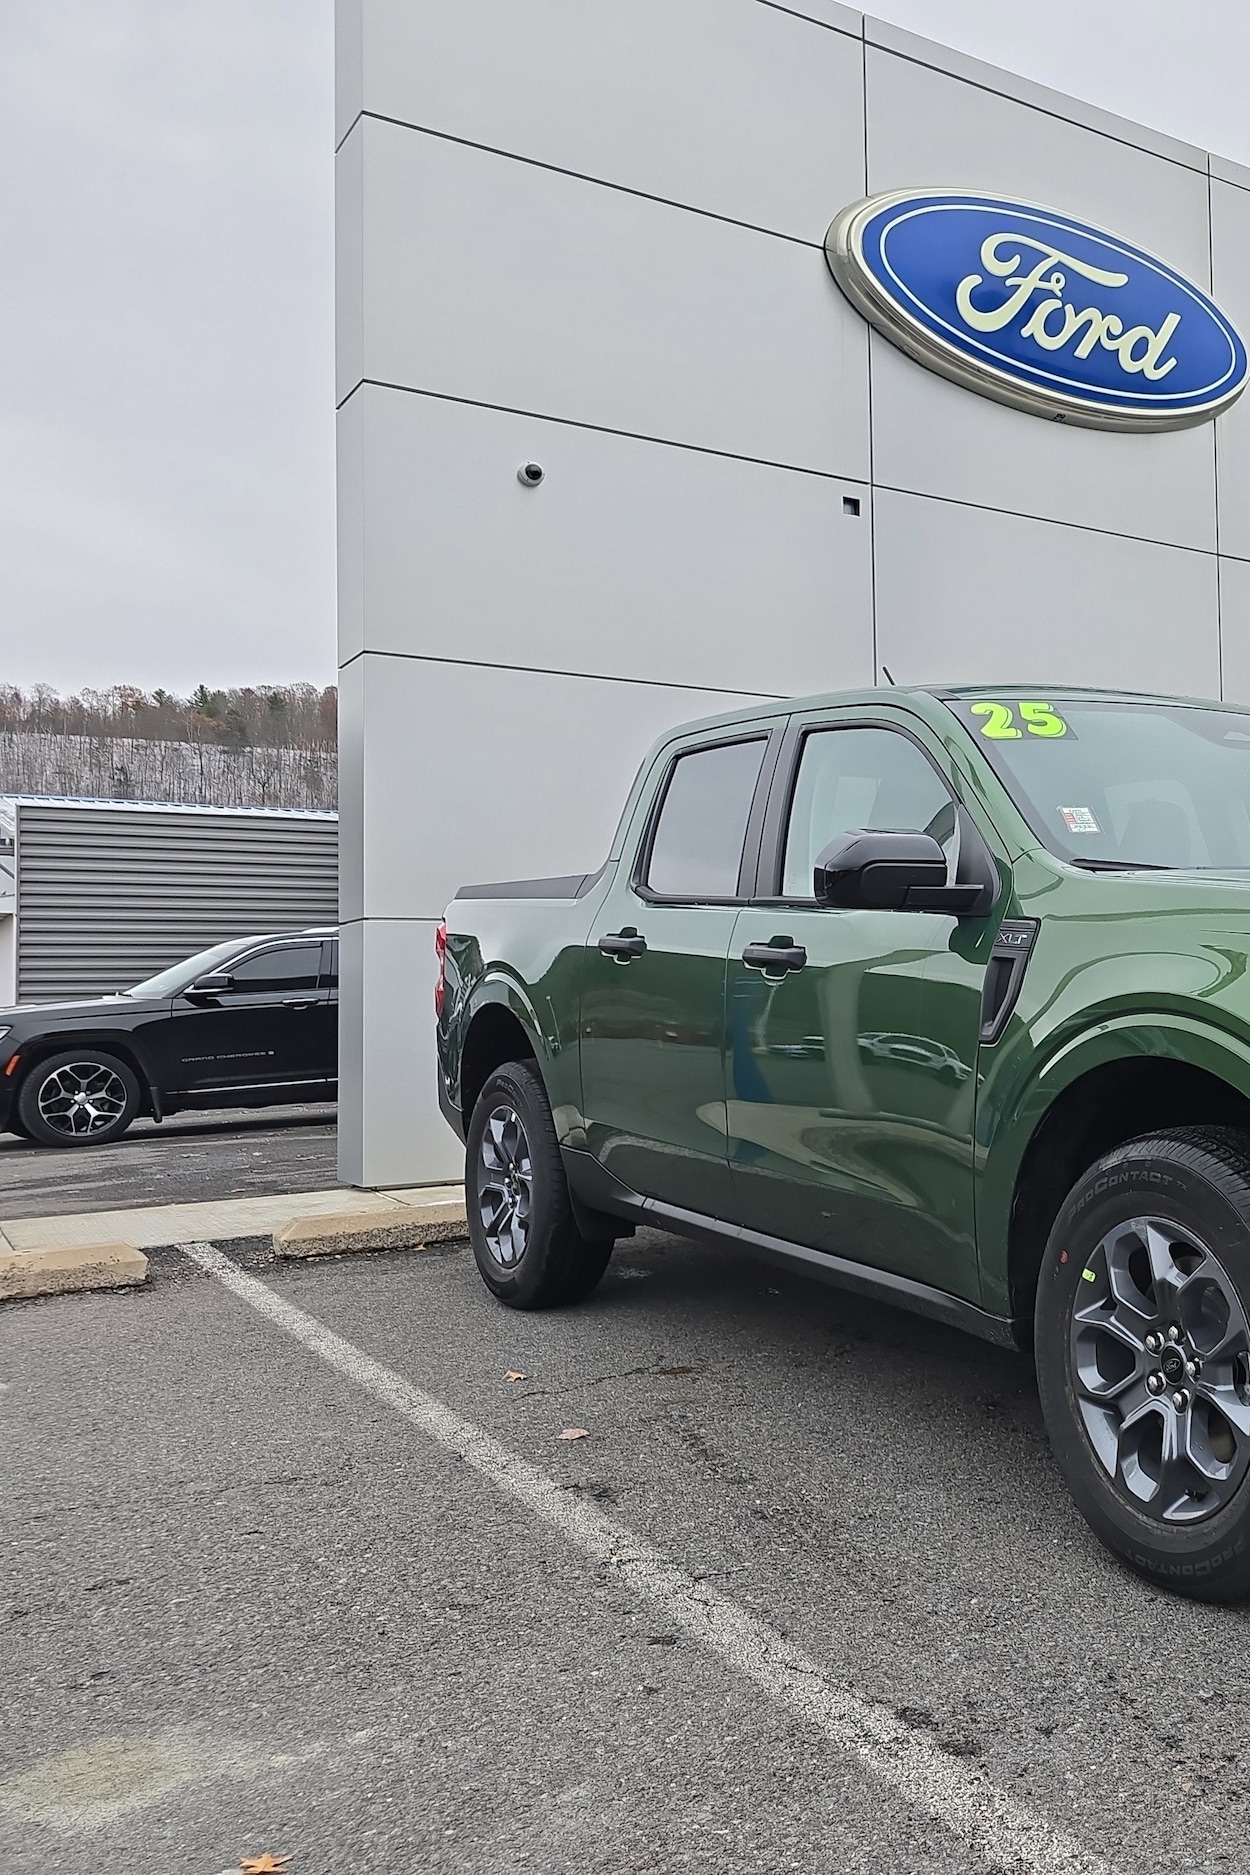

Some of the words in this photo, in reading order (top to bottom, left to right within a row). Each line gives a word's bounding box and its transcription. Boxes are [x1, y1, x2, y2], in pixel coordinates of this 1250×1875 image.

[956, 232, 1182, 381] Ford
[970, 701, 1068, 739] 25
[996, 932, 1028, 945] XLT
